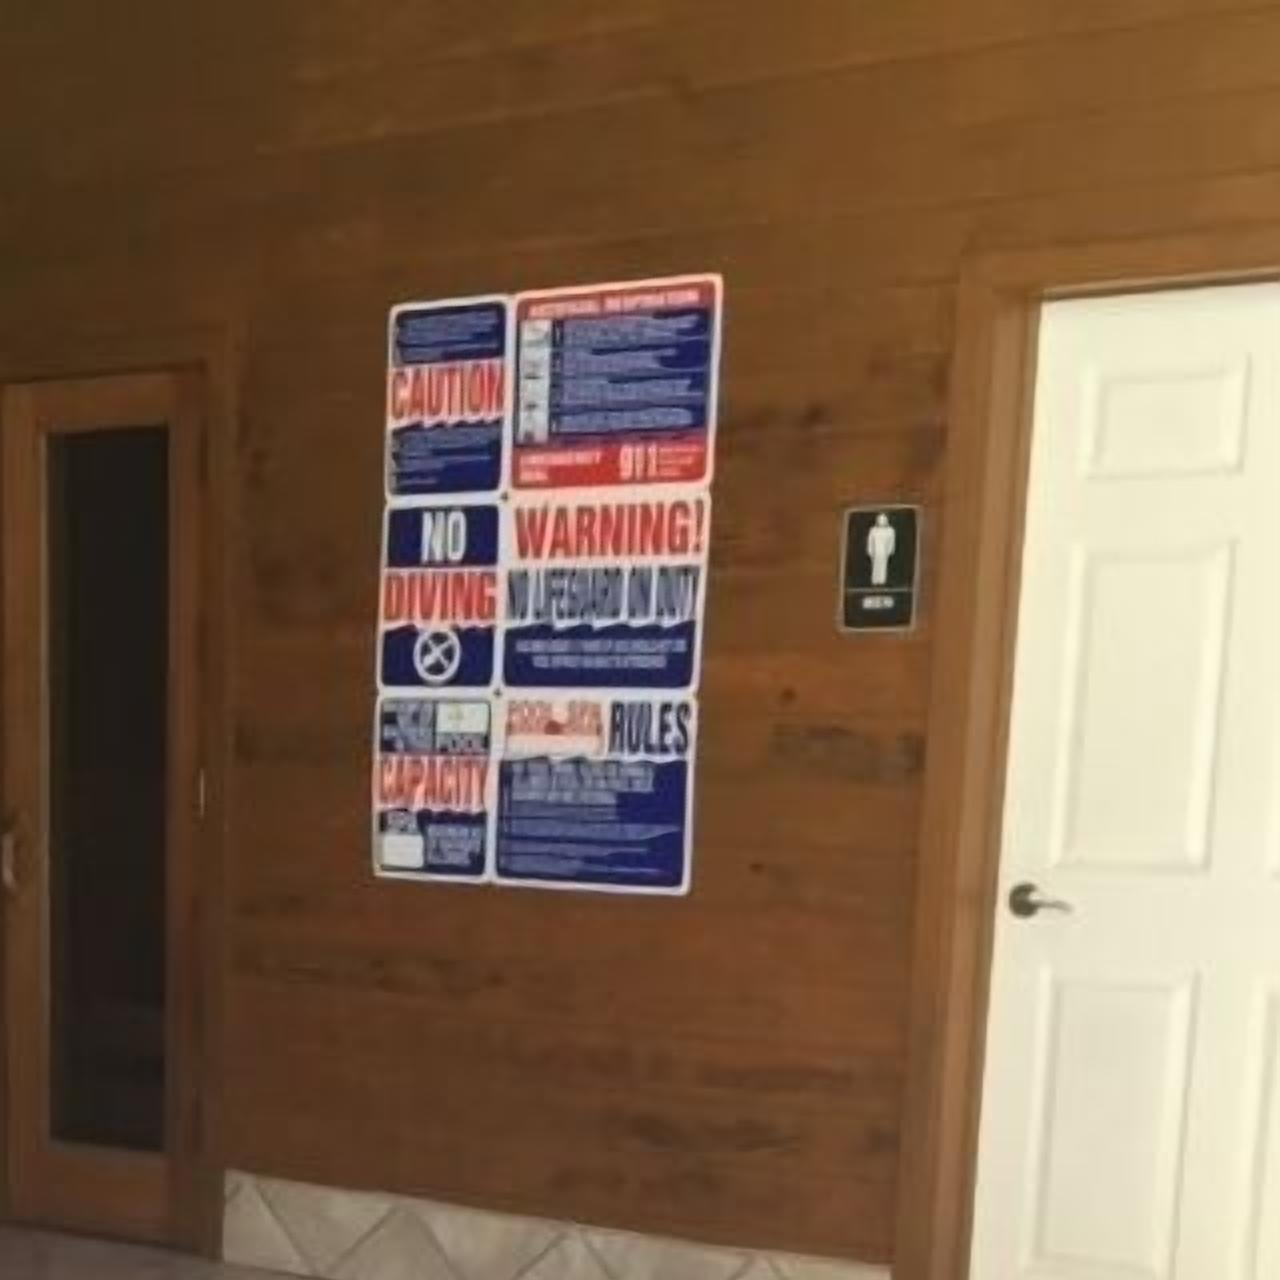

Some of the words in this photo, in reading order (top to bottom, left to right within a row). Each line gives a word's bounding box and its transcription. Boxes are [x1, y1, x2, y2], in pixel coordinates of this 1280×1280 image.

[391, 361, 504, 420] CAUTION
[619, 444, 658, 480] 911
[422, 511, 466, 562] NO
[515, 501, 706, 559] WARNING!
[384, 573, 498, 621] DIVING
[609, 701, 691, 755] RULES
[381, 755, 489, 809] CAPACITY
